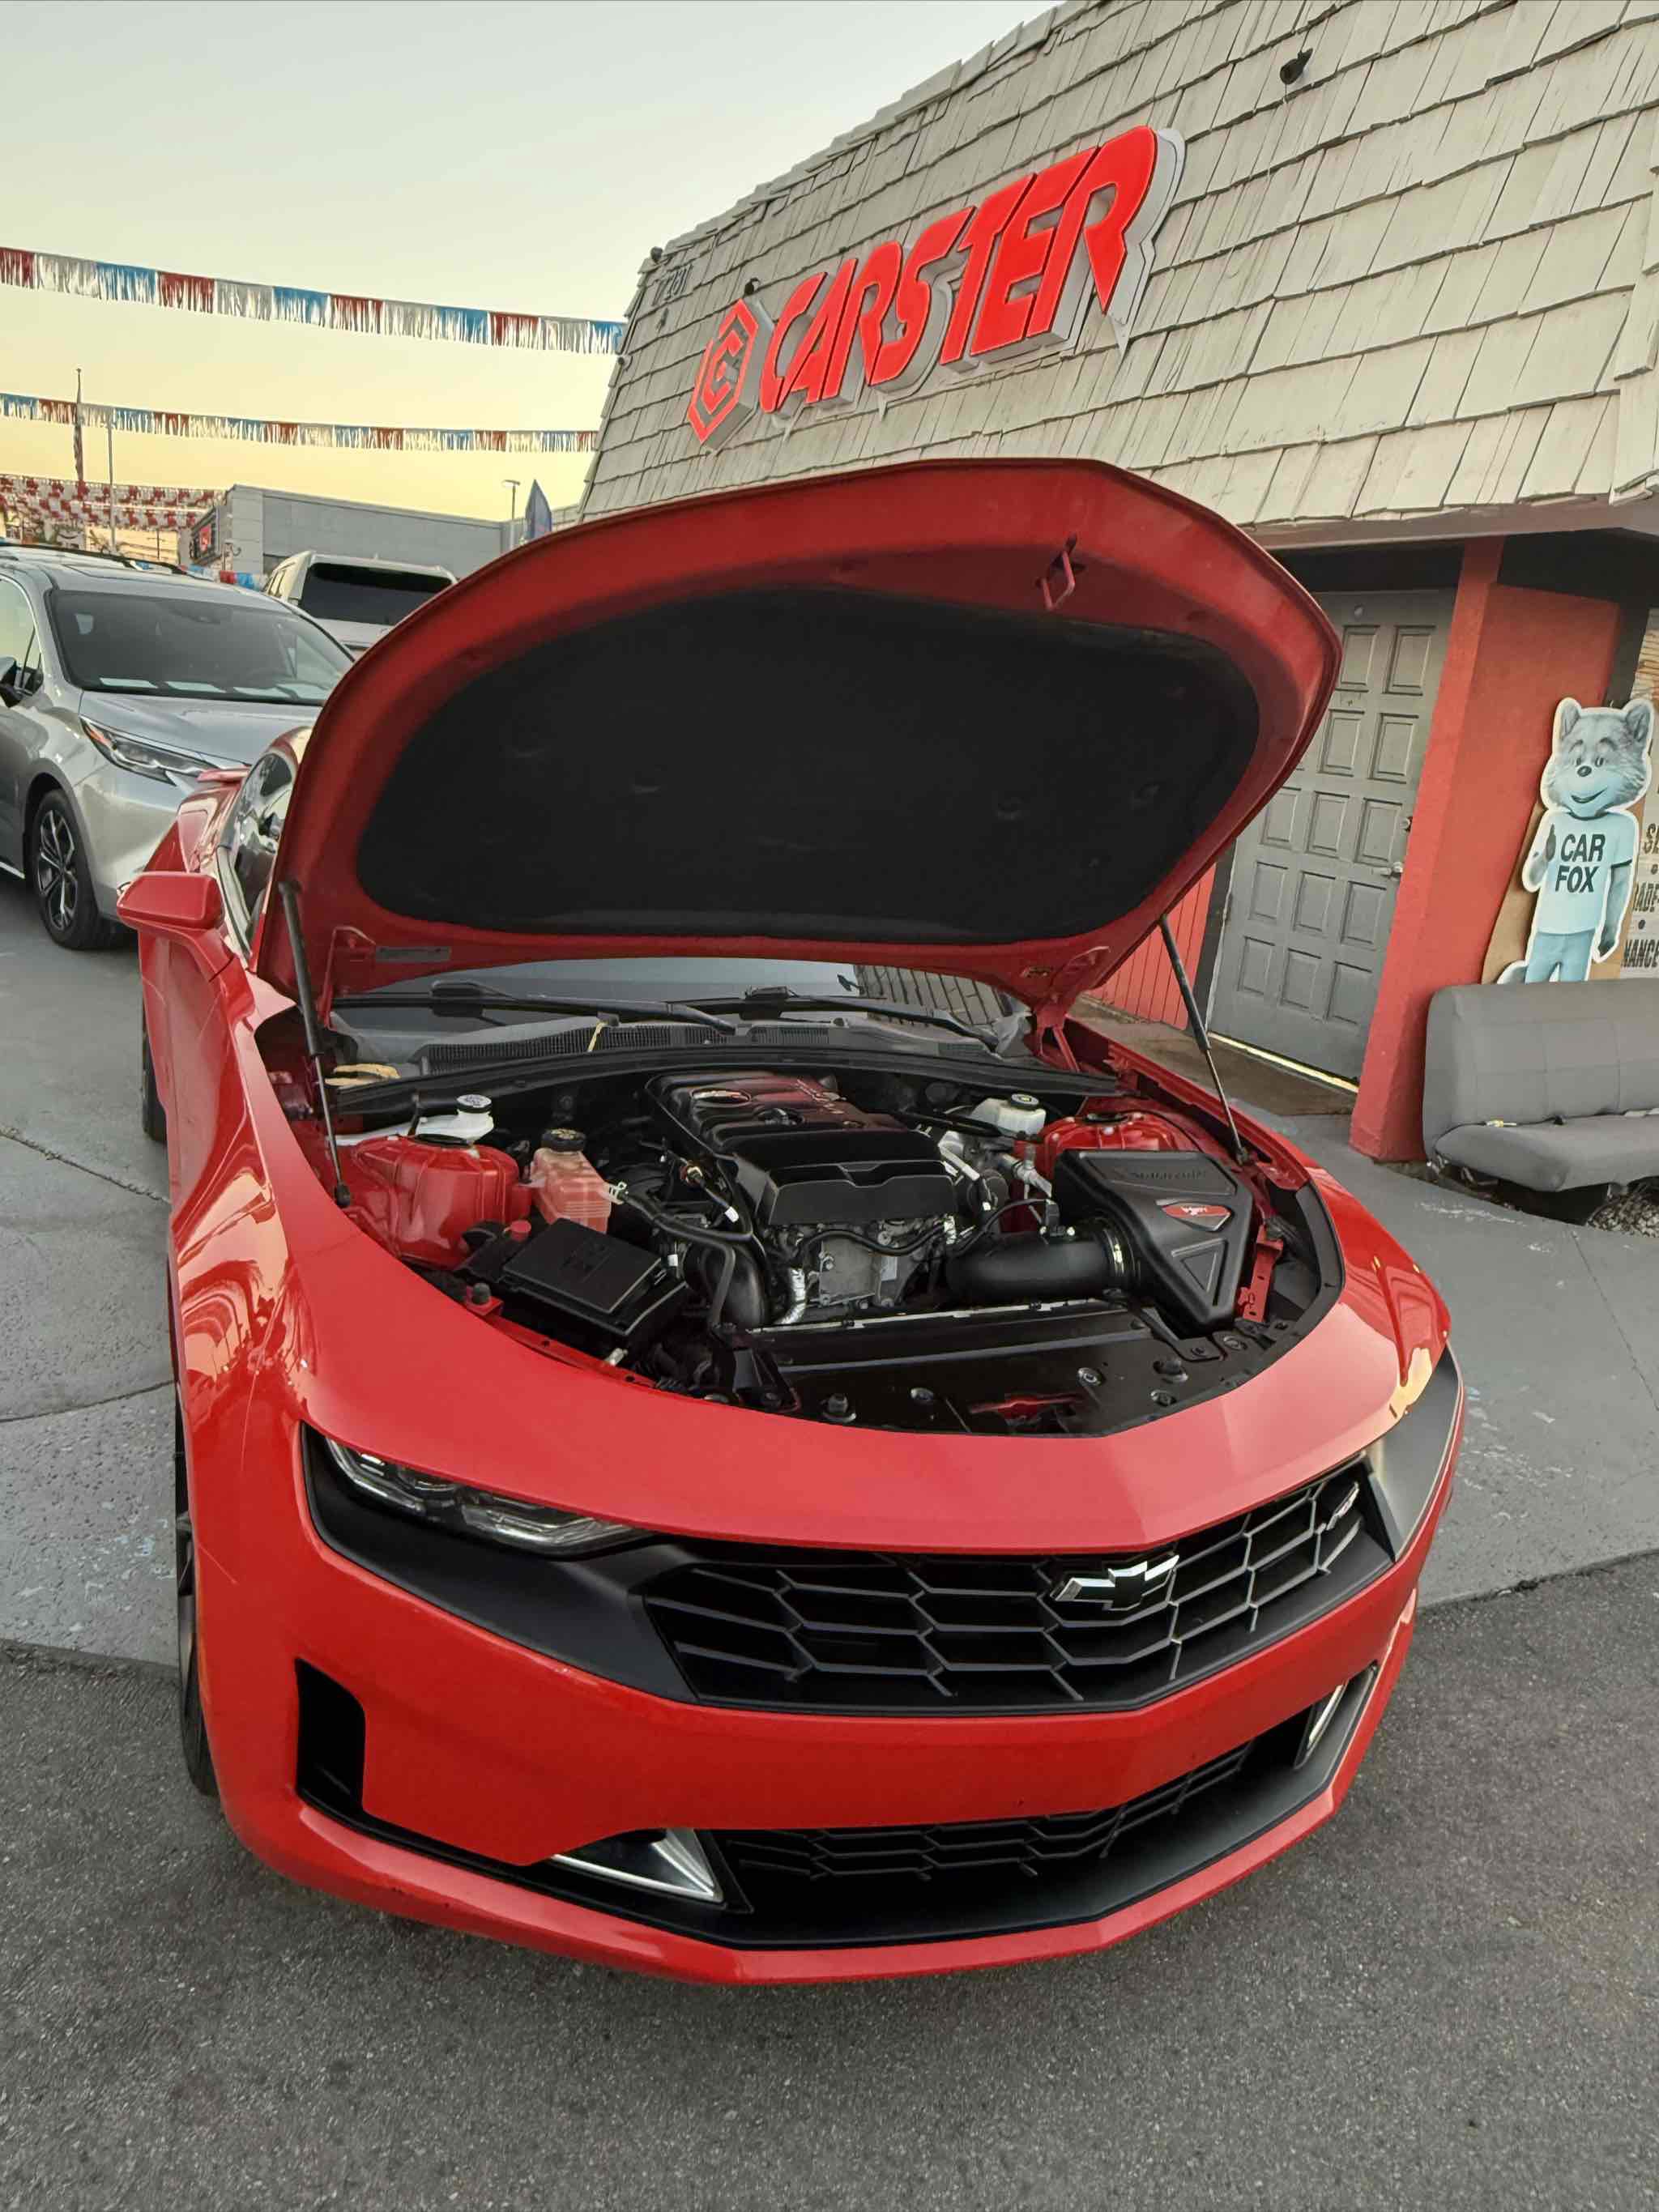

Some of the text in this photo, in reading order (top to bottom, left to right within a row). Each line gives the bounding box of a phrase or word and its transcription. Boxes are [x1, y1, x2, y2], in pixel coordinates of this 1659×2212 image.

[760, 125, 1158, 412] CARSTER
[1560, 833, 1606, 863] CAR
[1555, 865, 1599, 893] FOX
